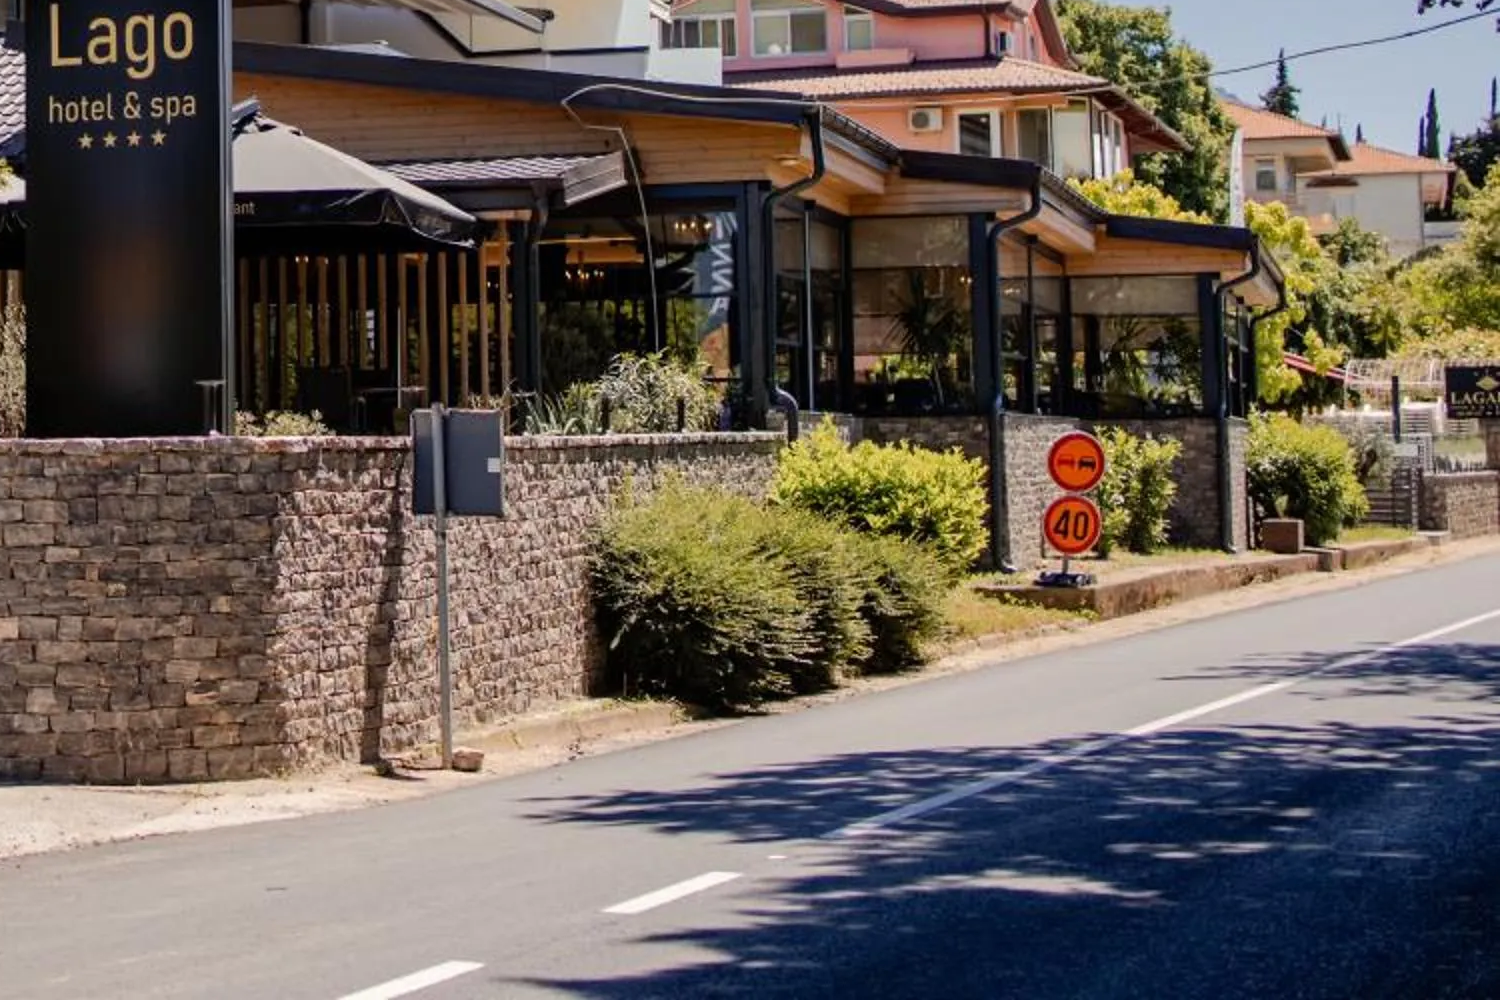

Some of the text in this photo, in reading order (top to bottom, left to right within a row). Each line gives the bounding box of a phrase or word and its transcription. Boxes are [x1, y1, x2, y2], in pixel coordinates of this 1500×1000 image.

[50, 2, 195, 80] Lago
[48, 90, 197, 125] hotel & spa
[1451, 391, 1500, 404] LAGA
[1053, 509, 1089, 541] 40
